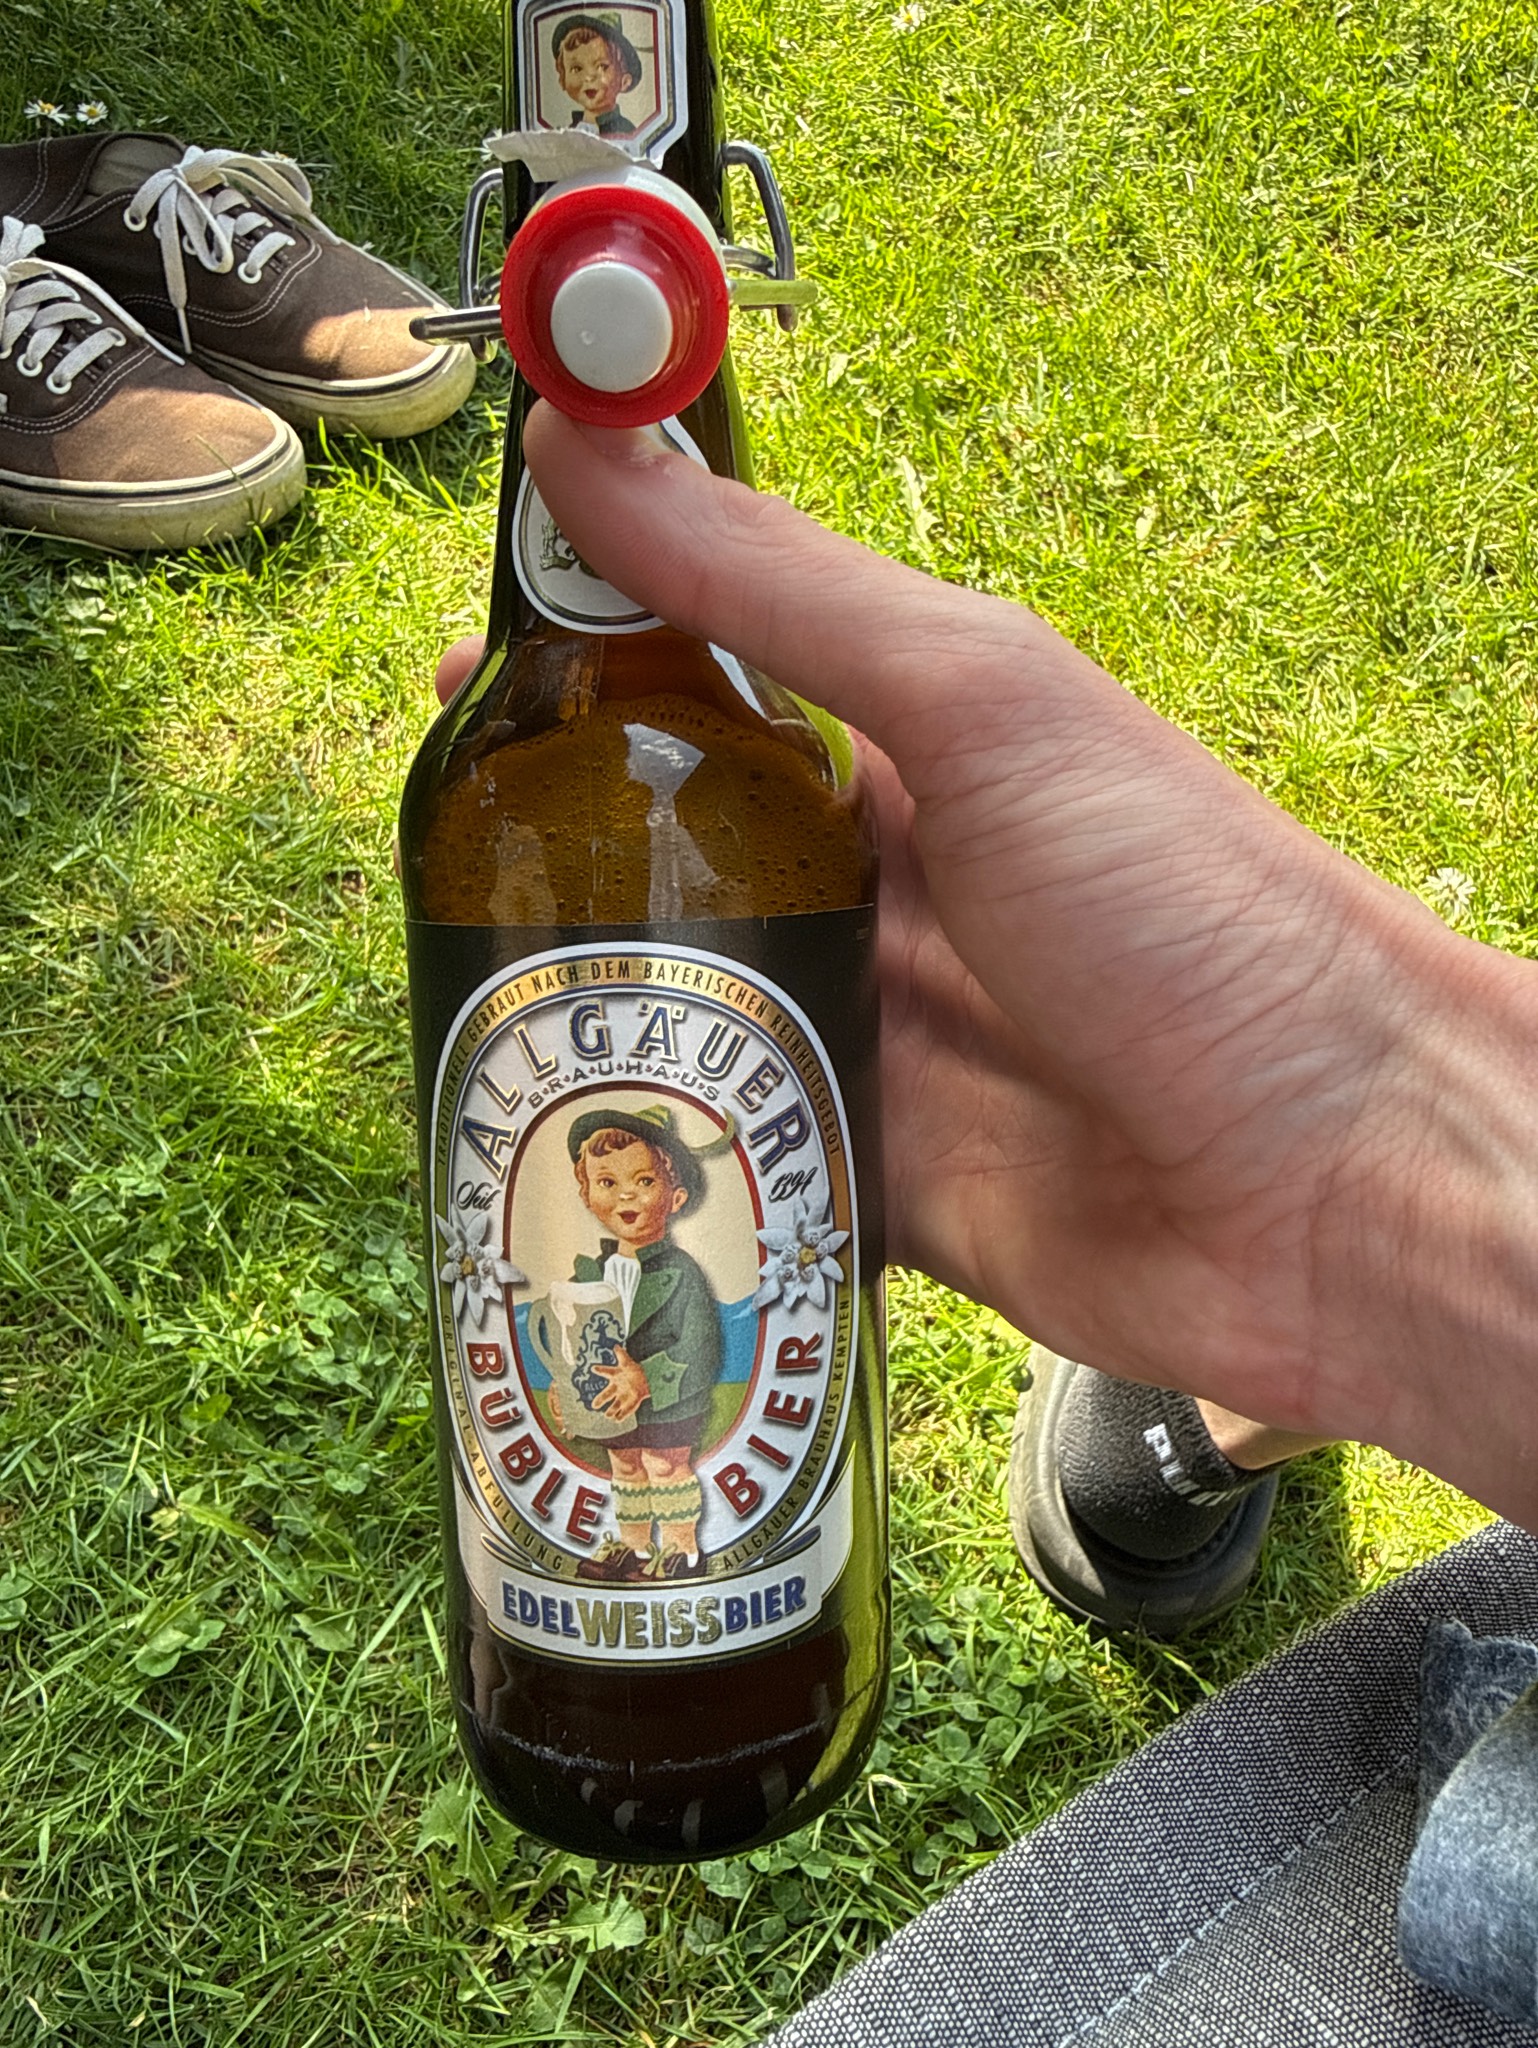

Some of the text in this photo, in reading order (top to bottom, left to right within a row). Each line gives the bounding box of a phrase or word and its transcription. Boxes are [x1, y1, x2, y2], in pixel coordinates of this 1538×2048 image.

[438, 960, 841, 1166] TRADITIONELL GEBRAUT NACH DEM BAYERISCHEN REINHEITSGEBOT
[460, 1001, 811, 1181] ALLGÄUER
[456, 1181, 502, 1211] Seit
[466, 1332, 822, 1544] BÜBLE BIER
[723, 1299, 850, 1570] ALLGÄUER BRAUHAUS KEMPTEN
